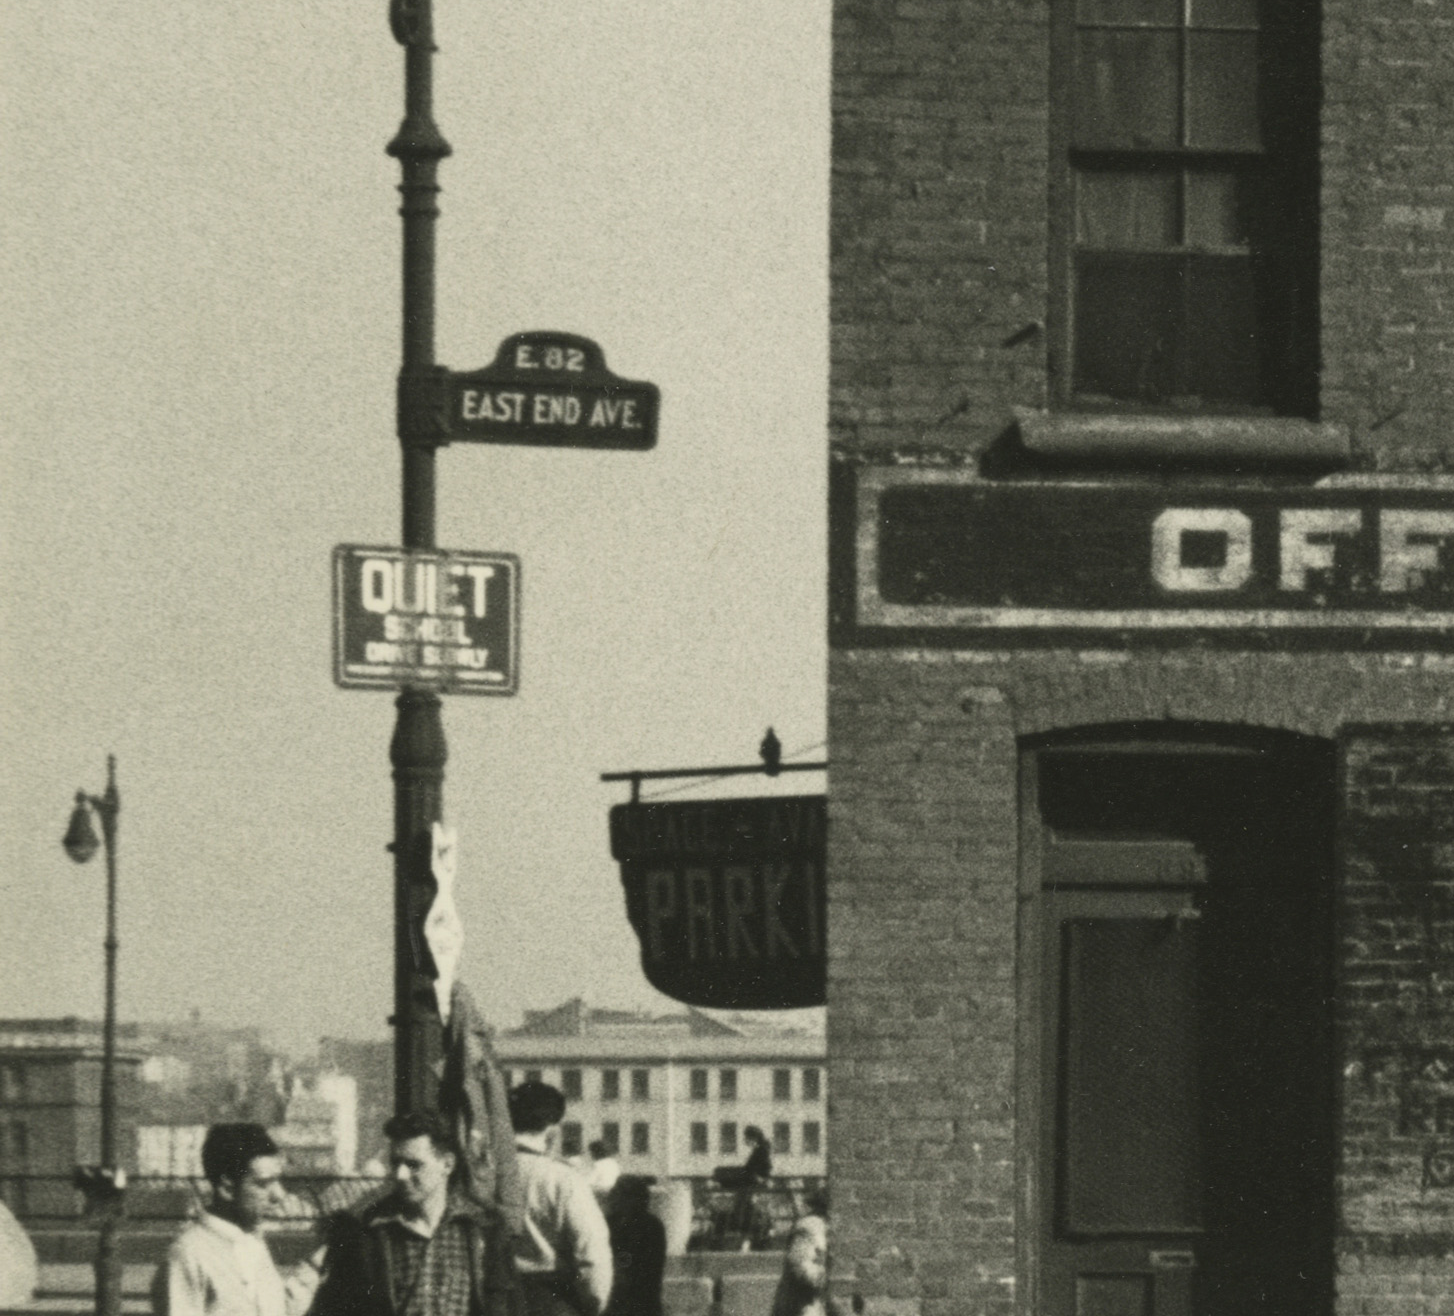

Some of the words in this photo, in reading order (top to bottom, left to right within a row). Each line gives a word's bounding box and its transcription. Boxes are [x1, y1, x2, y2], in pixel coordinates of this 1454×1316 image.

[515, 345, 540, 369] E.
[544, 348, 586, 372] 82
[462, 390, 525, 422] EAST
[533, 395, 581, 425] END
[590, 399, 643, 429] AVE.
[361, 558, 495, 619] QUIET
